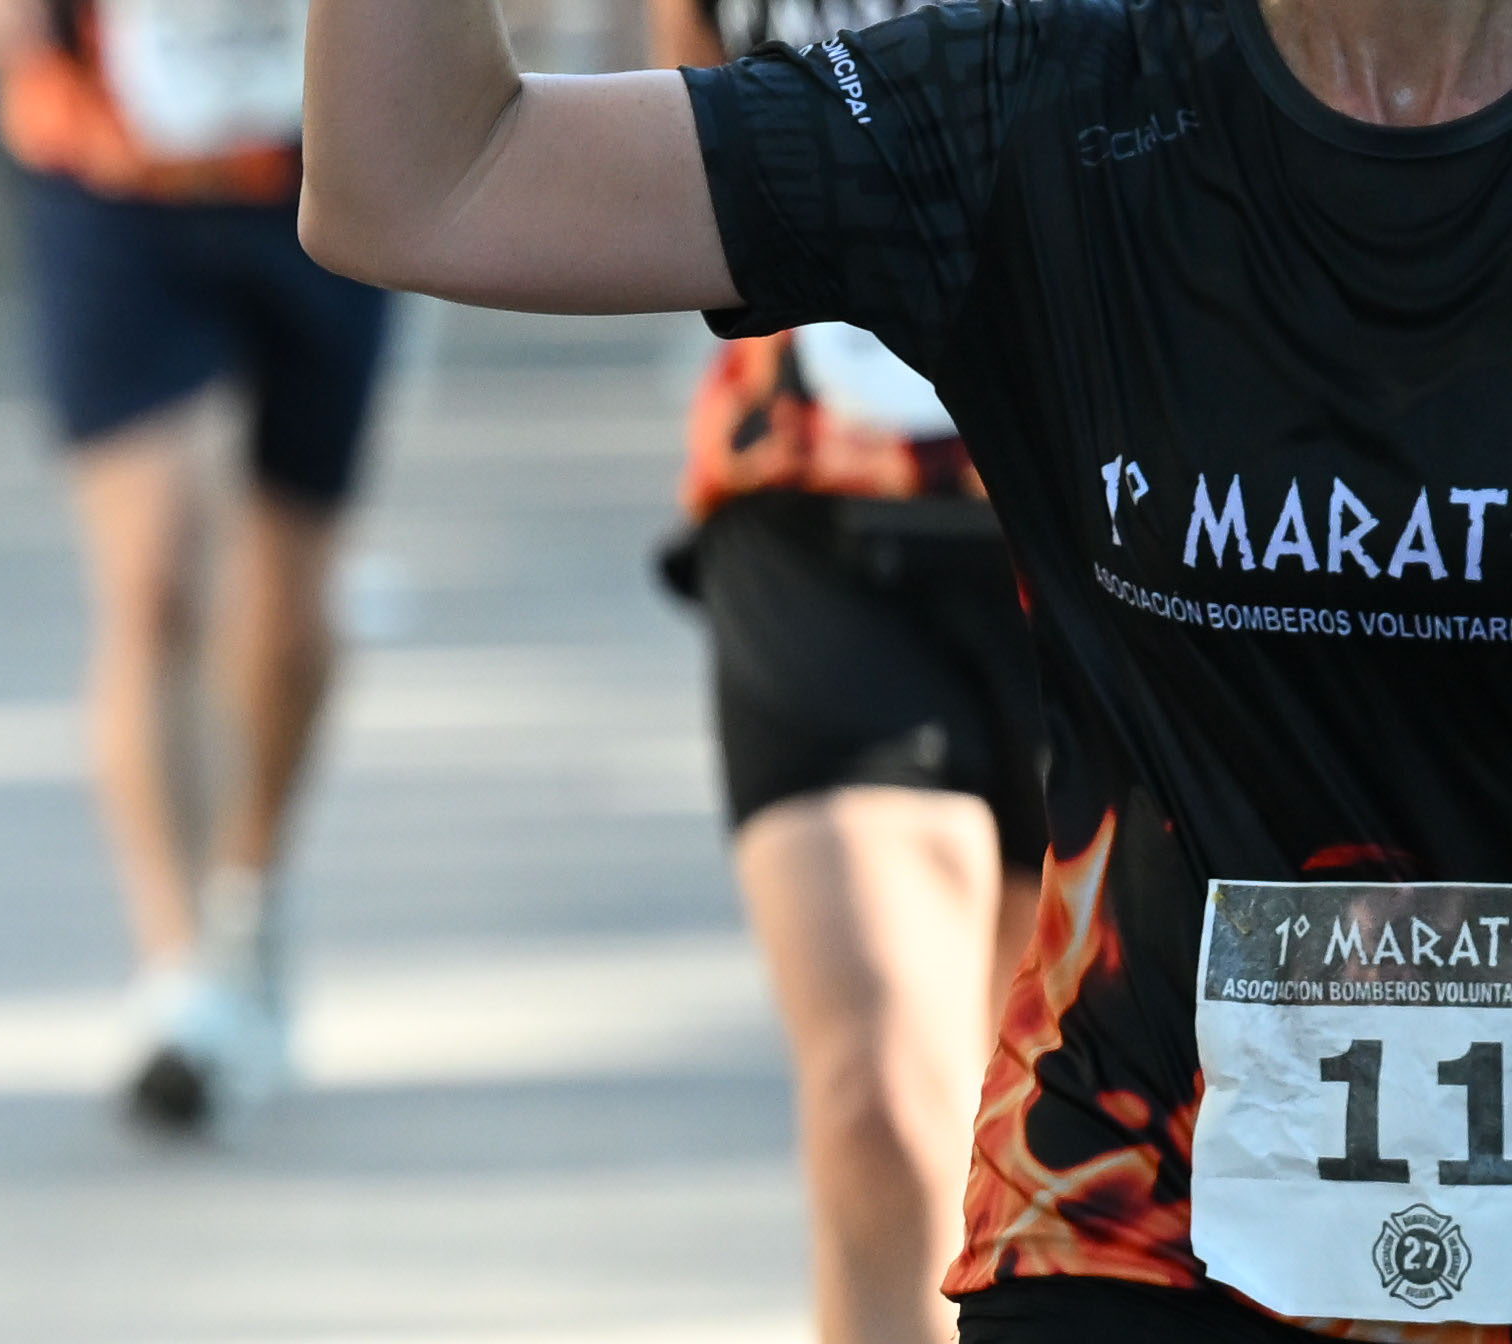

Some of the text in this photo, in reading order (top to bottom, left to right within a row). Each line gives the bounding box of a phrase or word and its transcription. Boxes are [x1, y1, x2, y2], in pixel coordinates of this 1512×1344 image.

[1182, 472, 1512, 583] MARAT
[1206, 602, 1353, 636] BOMBEROS
[1323, 915, 1512, 967] MARAT
[1329, 980, 1431, 1002] BOMBEROS
[1403, 1235, 1441, 1270] 27
